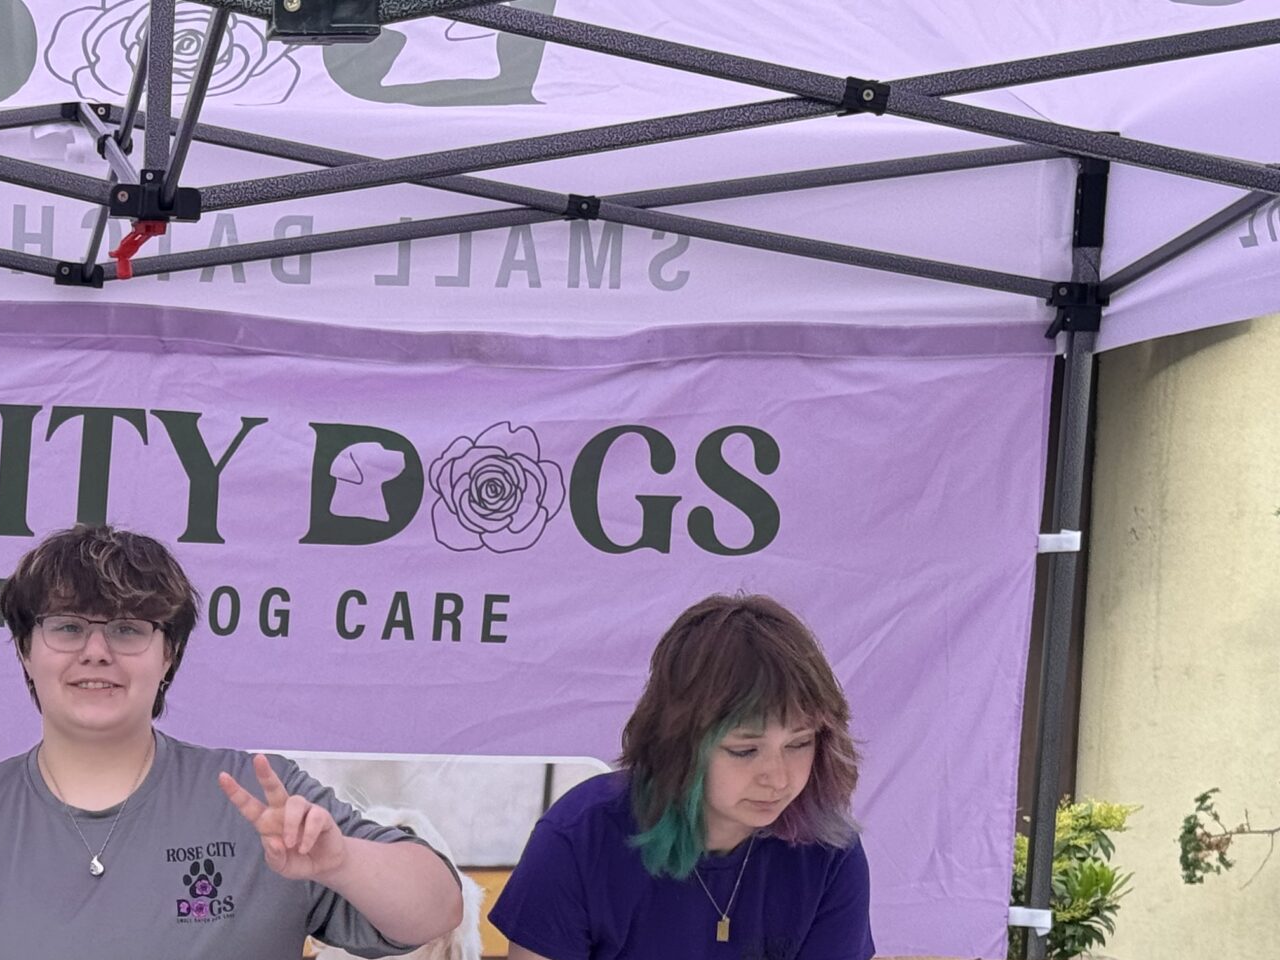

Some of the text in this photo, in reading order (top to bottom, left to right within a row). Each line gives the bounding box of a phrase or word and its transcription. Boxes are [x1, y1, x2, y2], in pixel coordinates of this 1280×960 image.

[208, 586, 291, 637] OG
[335, 589, 510, 643] CARE
[166, 841, 236, 862] ROSE CITY
